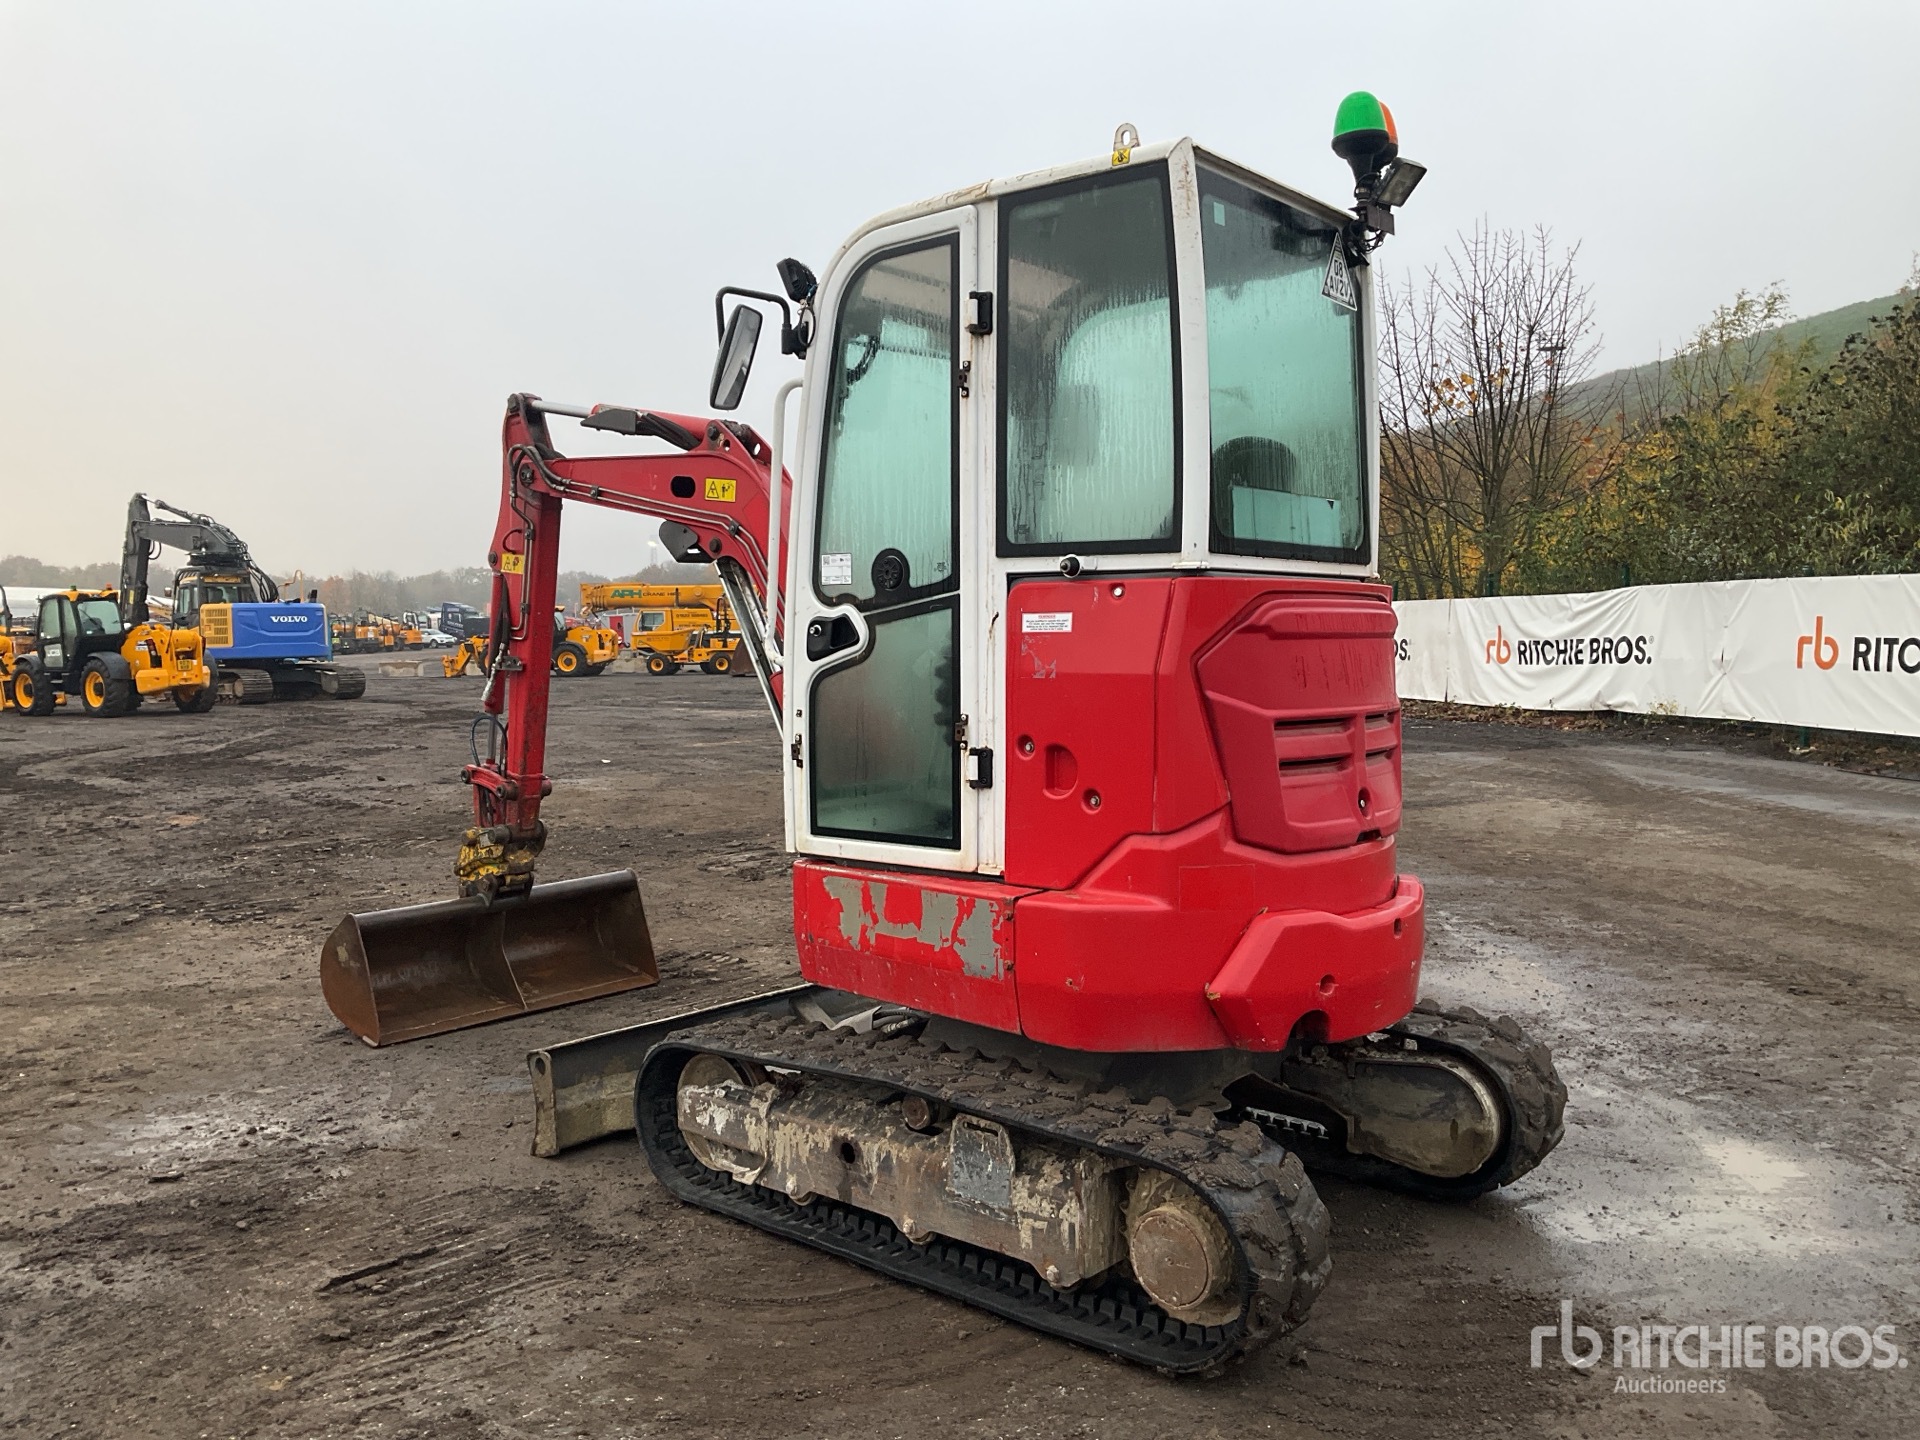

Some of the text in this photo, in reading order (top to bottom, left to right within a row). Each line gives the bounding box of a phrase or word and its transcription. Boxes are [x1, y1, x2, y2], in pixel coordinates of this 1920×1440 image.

[610, 589, 642, 598] APH
[270, 615, 308, 623] VOLVO
[1486, 625, 1652, 665] rb RITCHIE BROS.
[1797, 616, 1920, 674] rb RITC
